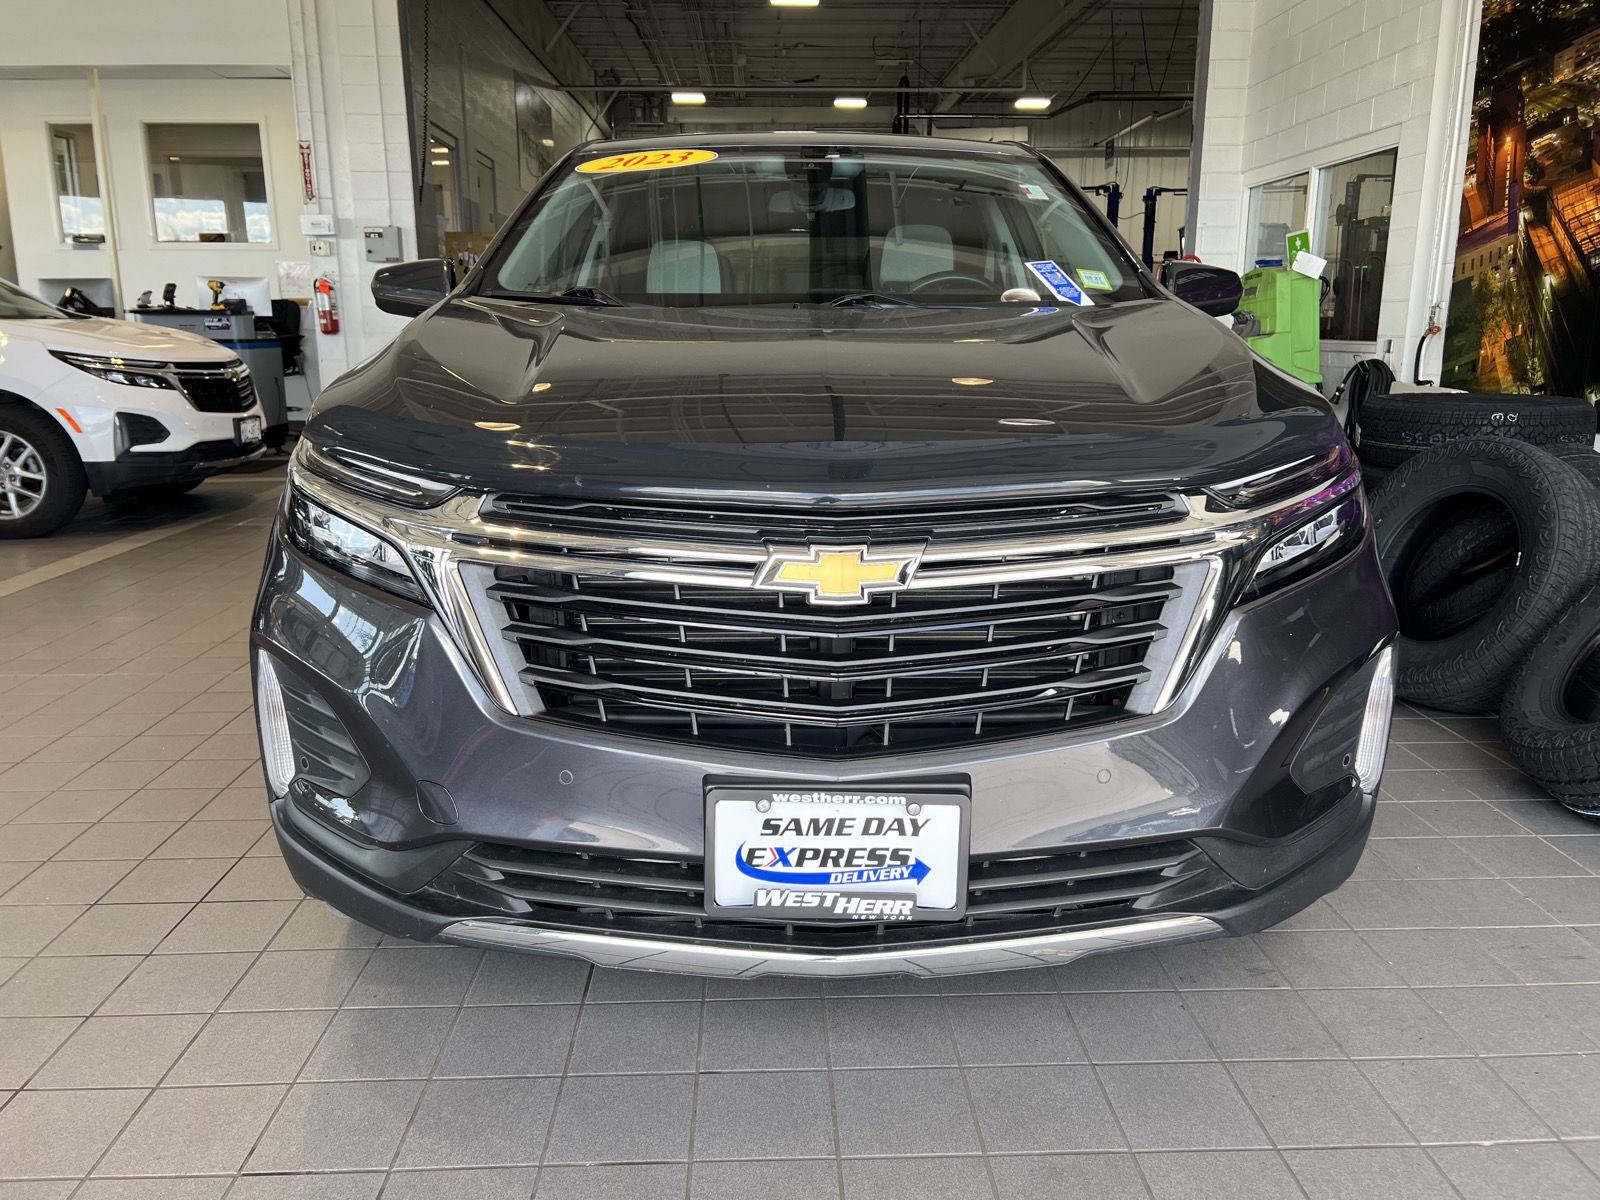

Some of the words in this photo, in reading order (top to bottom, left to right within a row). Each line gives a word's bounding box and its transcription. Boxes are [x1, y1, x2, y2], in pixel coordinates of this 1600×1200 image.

[598, 151, 694, 170] 2023
[772, 792, 907, 805] westherr.com
[760, 817, 857, 836] SAME
[861, 818, 932, 837] DAY
[744, 847, 913, 868] EXPRESS
[829, 865, 914, 884] DELIVERY
